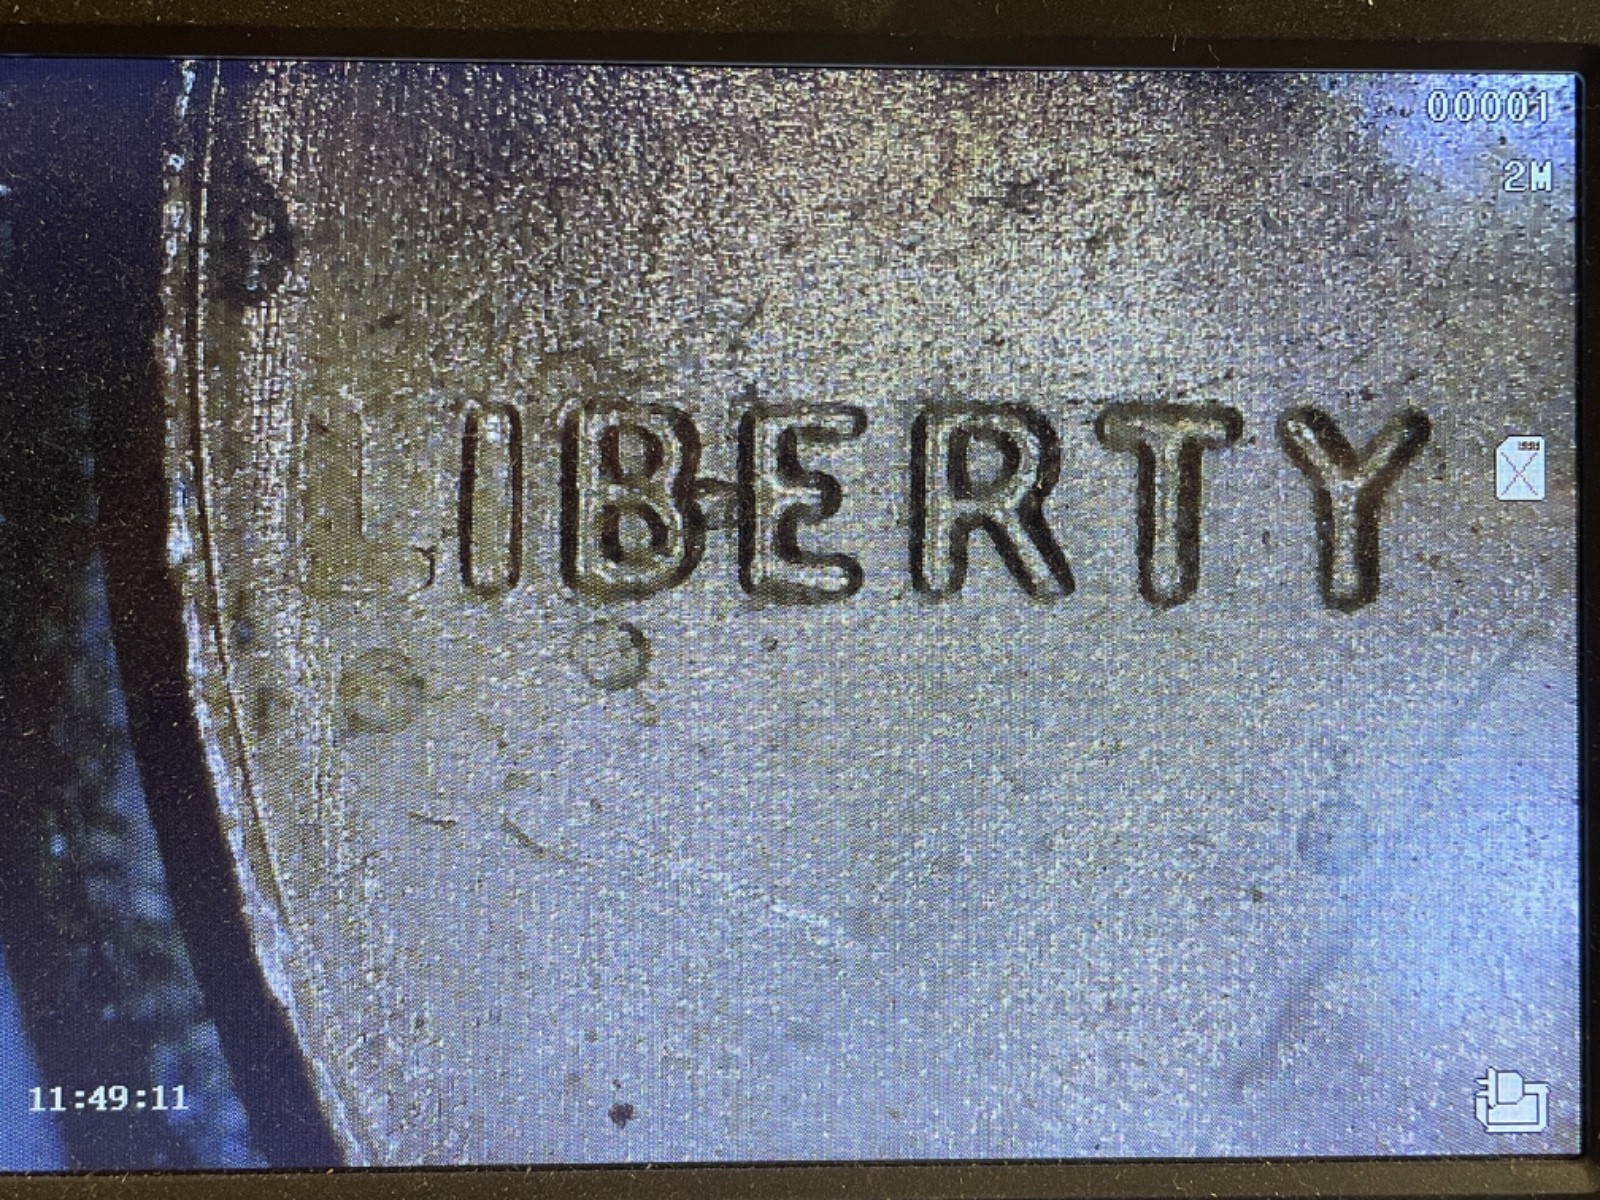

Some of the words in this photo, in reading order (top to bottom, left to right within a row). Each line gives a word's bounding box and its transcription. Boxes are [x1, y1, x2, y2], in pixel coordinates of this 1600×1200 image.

[1426, 87, 1549, 123] 00001
[1503, 159, 1553, 192] 2M
[28, 1084, 190, 1112] 11:49:11
